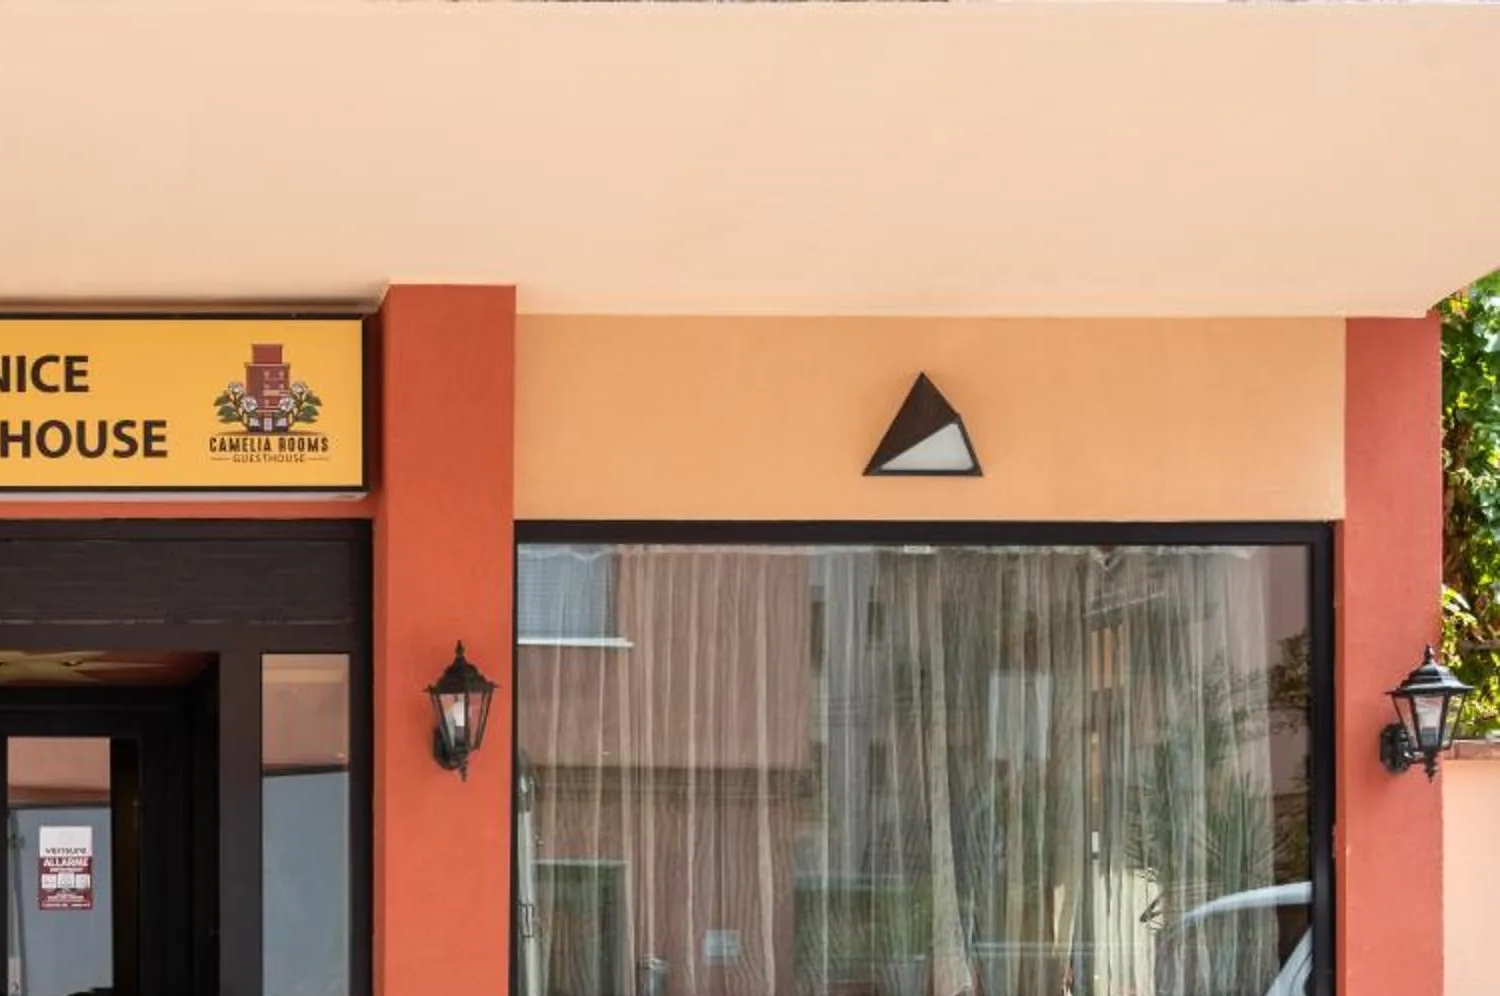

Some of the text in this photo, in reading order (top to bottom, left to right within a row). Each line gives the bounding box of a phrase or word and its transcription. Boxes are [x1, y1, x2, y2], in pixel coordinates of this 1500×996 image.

[209, 437, 329, 453] CAMELIA ROOMS
[232, 453, 305, 463] GUESTHOUSE
